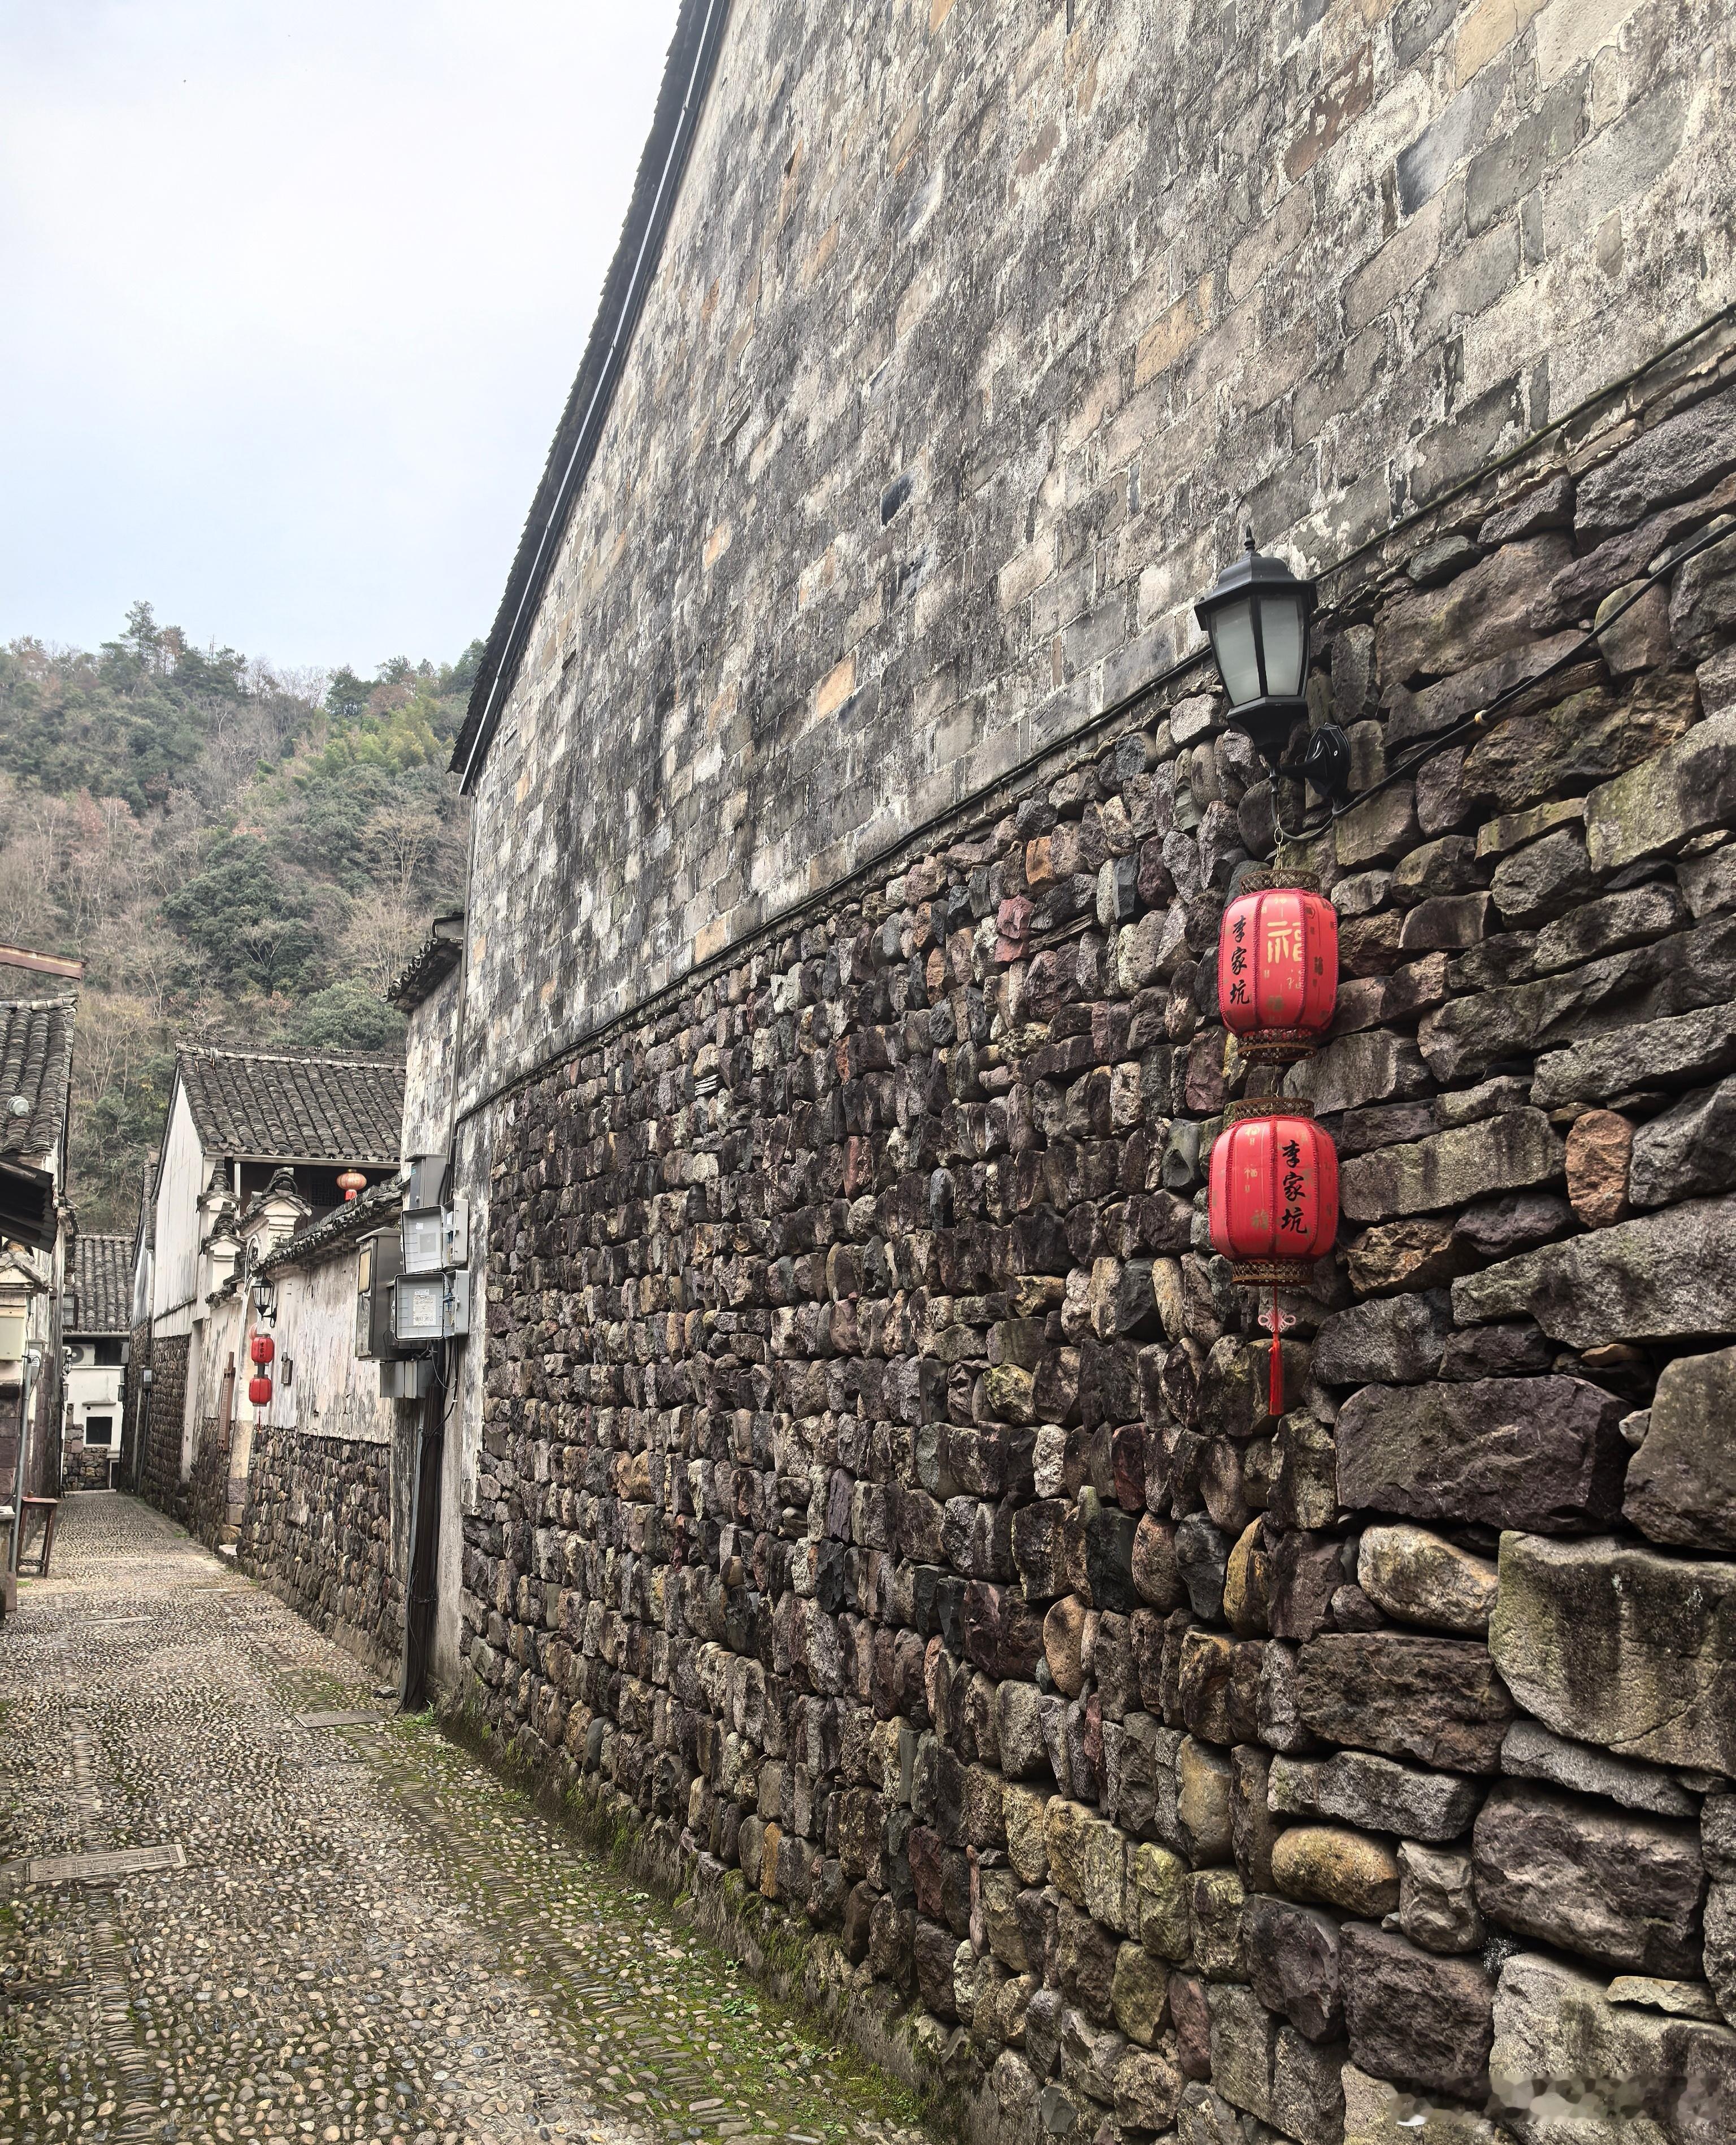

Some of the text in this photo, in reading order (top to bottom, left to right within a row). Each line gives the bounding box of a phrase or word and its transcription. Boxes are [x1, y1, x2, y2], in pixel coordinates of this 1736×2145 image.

[1230, 915, 1250, 1005] 李家坑
[1281, 1139, 1308, 1234] 李家坑
